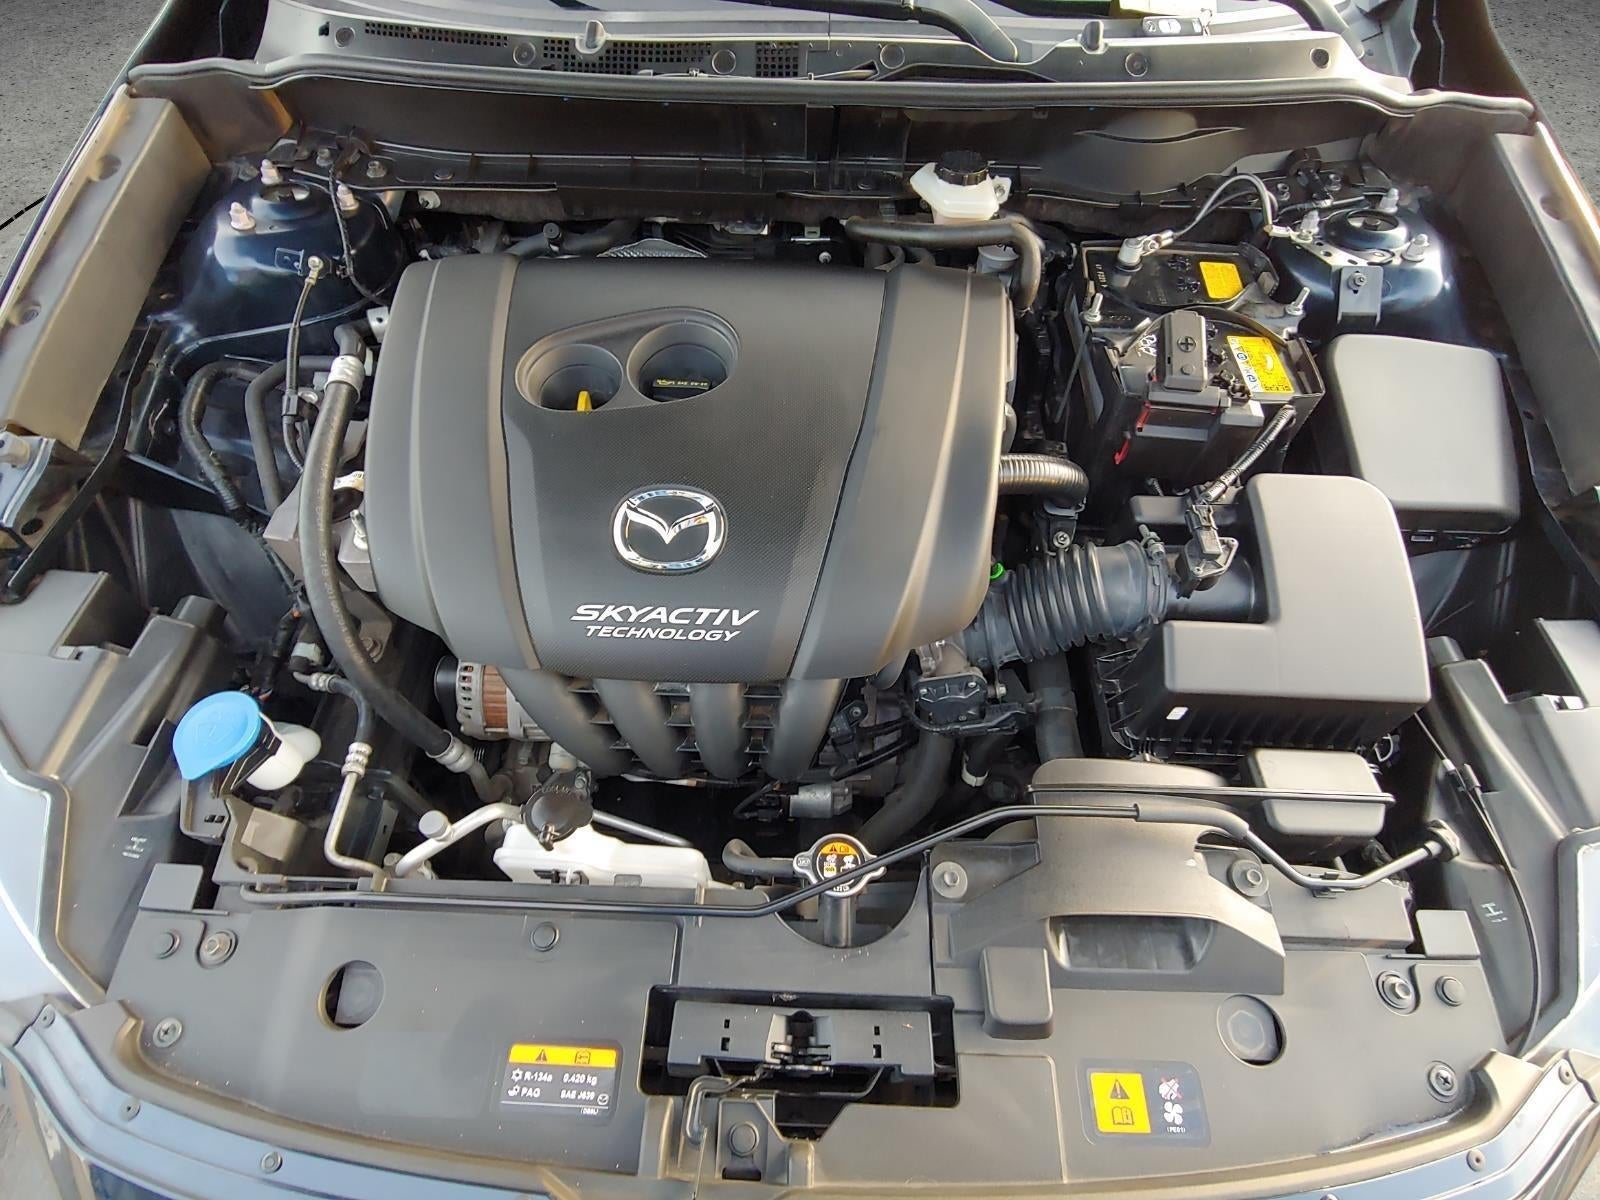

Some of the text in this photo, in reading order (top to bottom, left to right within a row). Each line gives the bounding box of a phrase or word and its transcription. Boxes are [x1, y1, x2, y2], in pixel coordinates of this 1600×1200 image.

[570, 604, 760, 626] SKYACTIV
[585, 625, 742, 642] TECHNOLOGY
[524, 1071, 597, 1086] R-134a 0.420 kg
